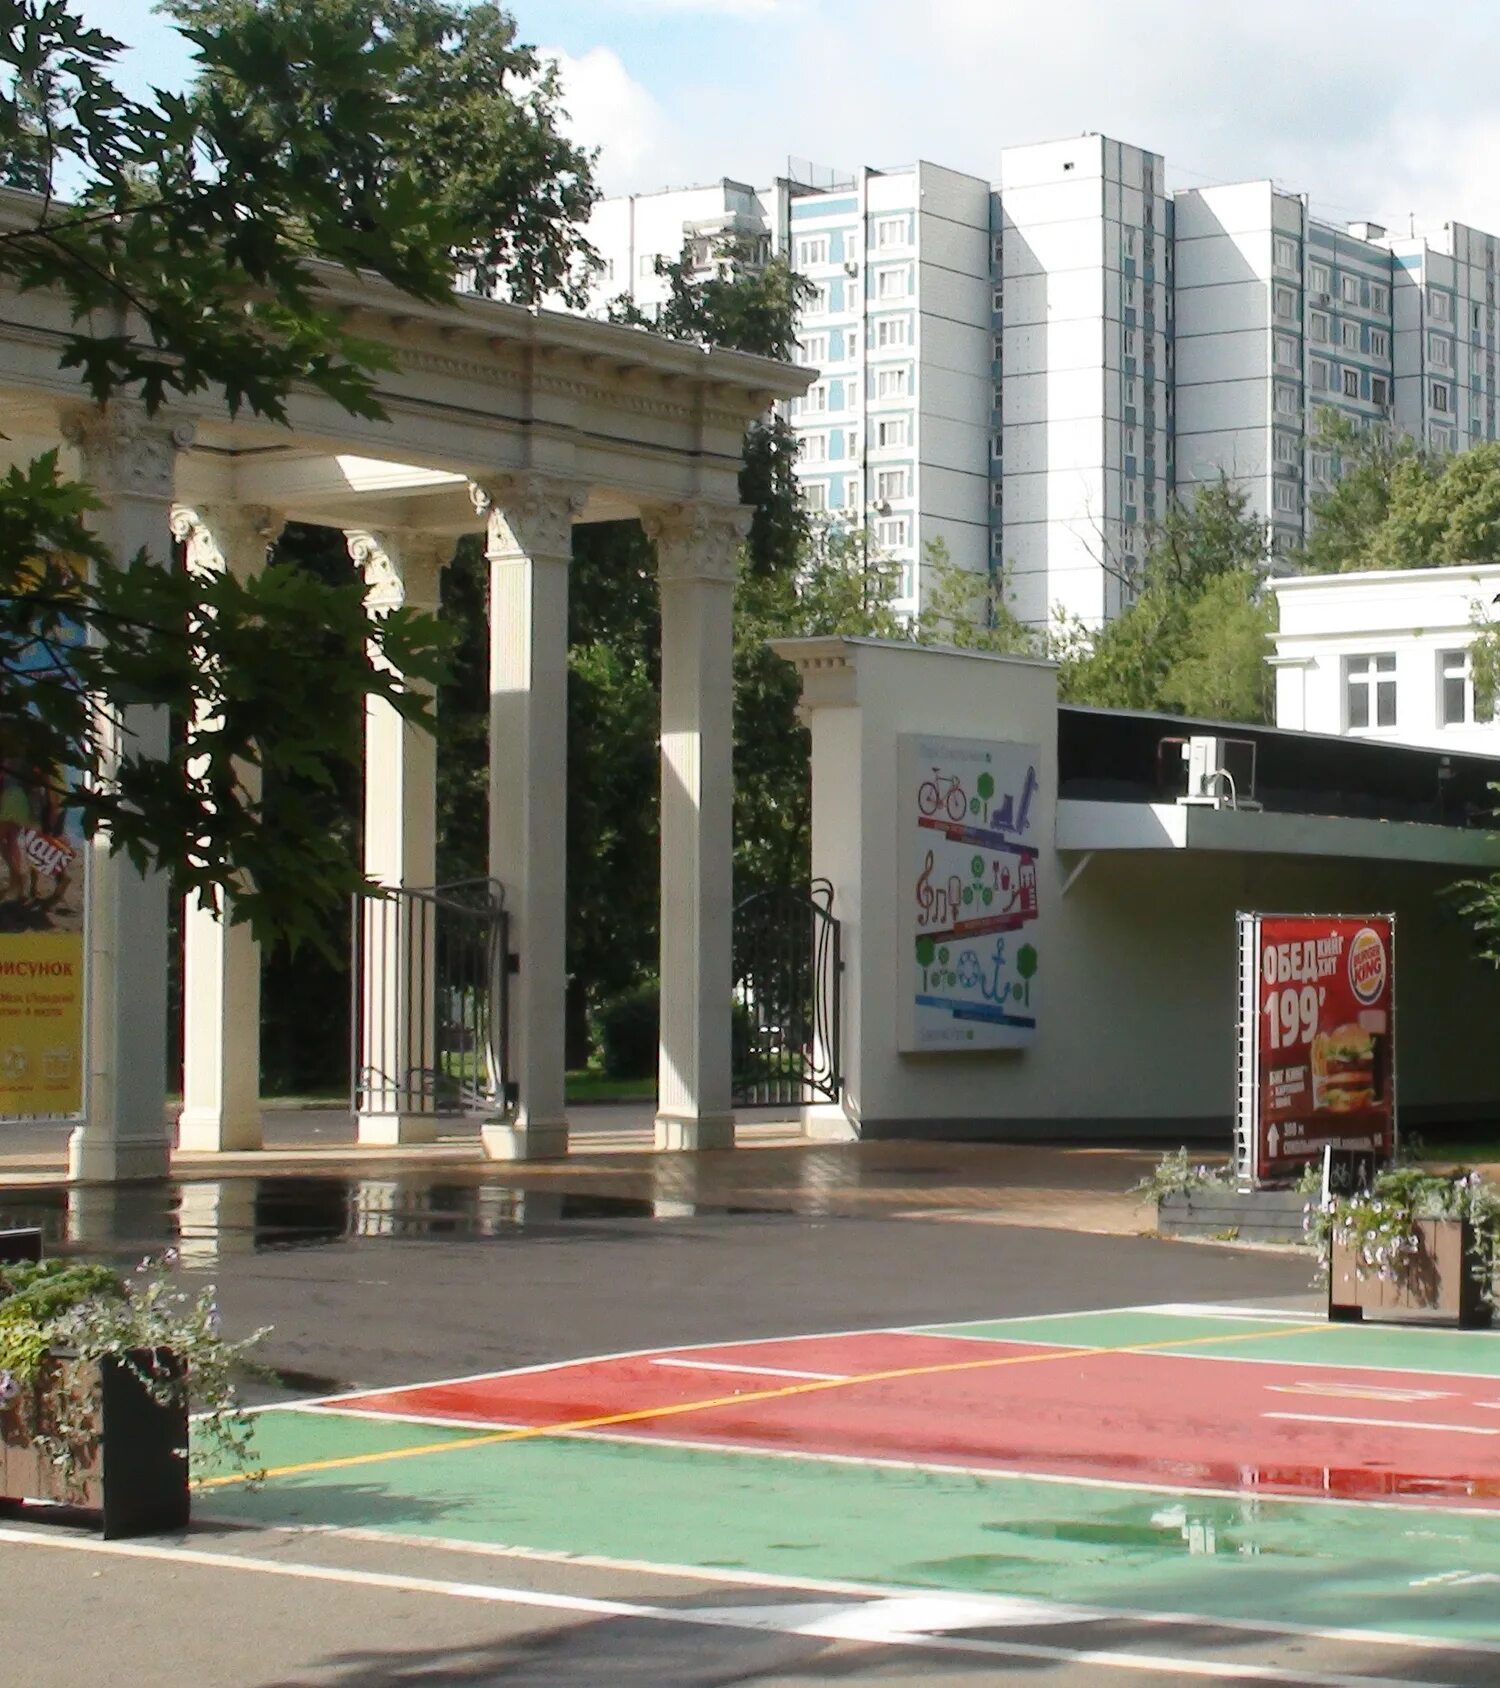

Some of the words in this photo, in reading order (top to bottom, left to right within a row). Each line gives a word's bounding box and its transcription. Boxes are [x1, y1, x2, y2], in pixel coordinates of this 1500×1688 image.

[0, 960, 73, 977] ИСУНОК
[1264, 940, 1318, 985] ОБЕД
[1355, 958, 1381, 985] KING
